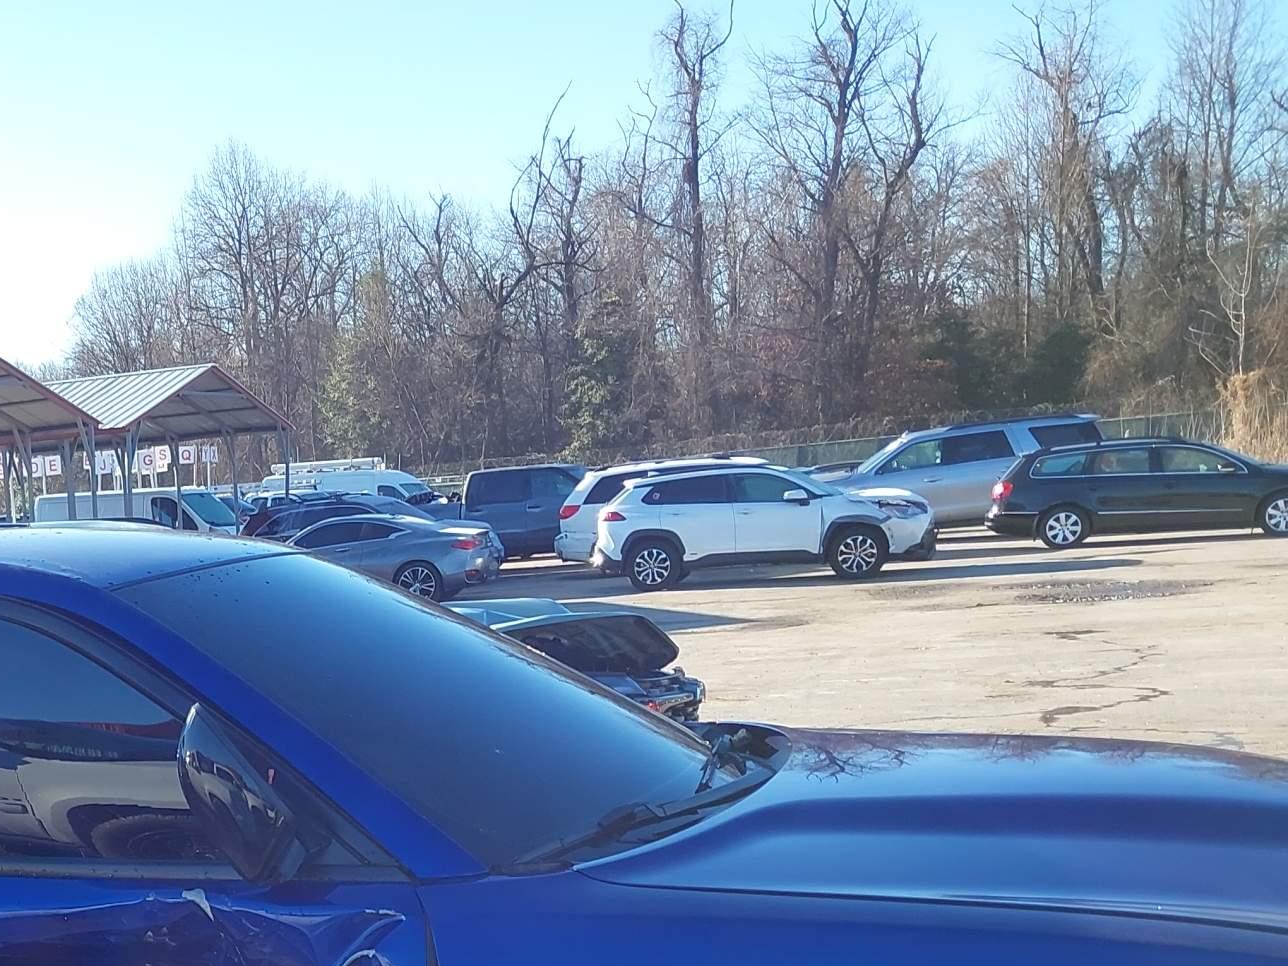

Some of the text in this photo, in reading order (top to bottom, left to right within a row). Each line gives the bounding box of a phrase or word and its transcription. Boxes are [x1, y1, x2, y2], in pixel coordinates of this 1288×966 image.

[143, 454, 153, 466] G
[159, 449, 167, 460] S
[181, 449, 191, 461] Q
[50, 460, 58, 471] E
